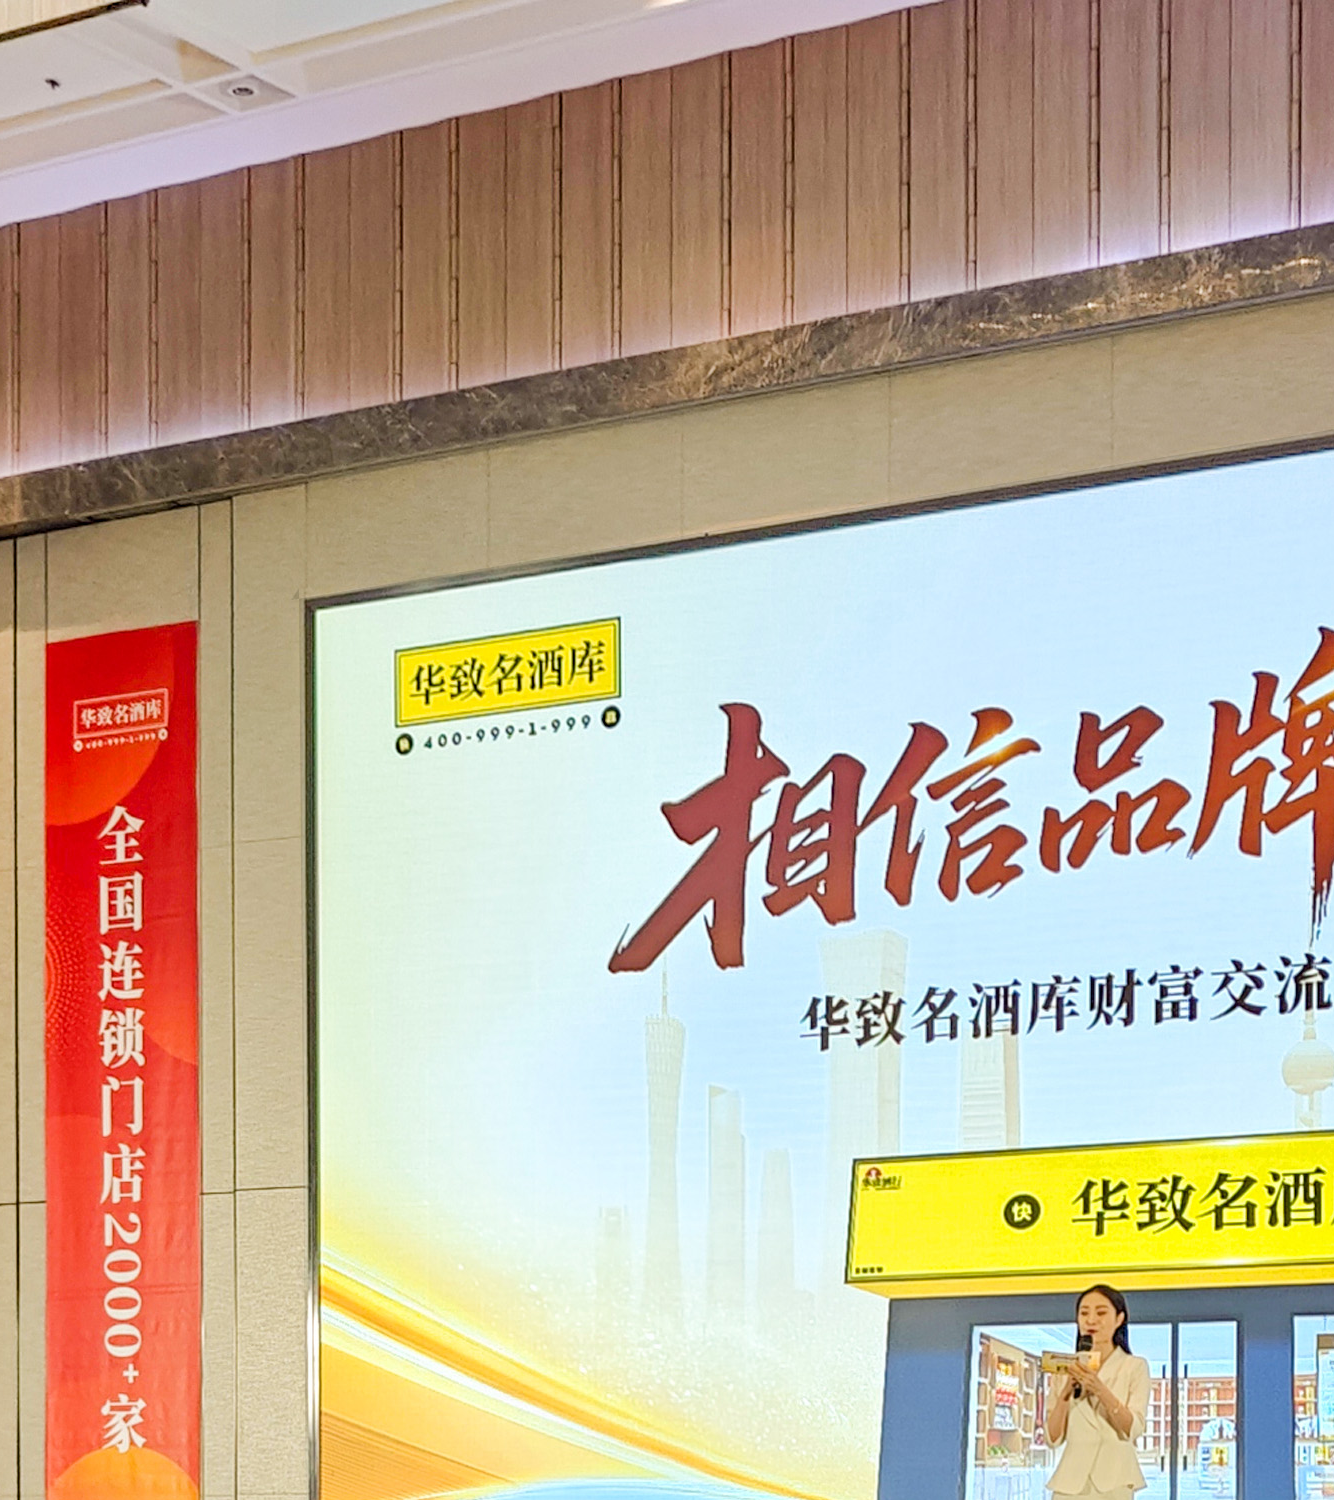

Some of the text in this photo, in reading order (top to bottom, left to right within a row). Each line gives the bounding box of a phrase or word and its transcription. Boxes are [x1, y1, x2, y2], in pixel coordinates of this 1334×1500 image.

[408, 639, 606, 706] 华致名酒库
[80, 698, 163, 729] 华致名酒库
[423, 714, 592, 749] 400-999-1-999
[96, 805, 149, 1451] 全国连锁门店2000+家
[1011, 1201, 1033, 1222] 快
